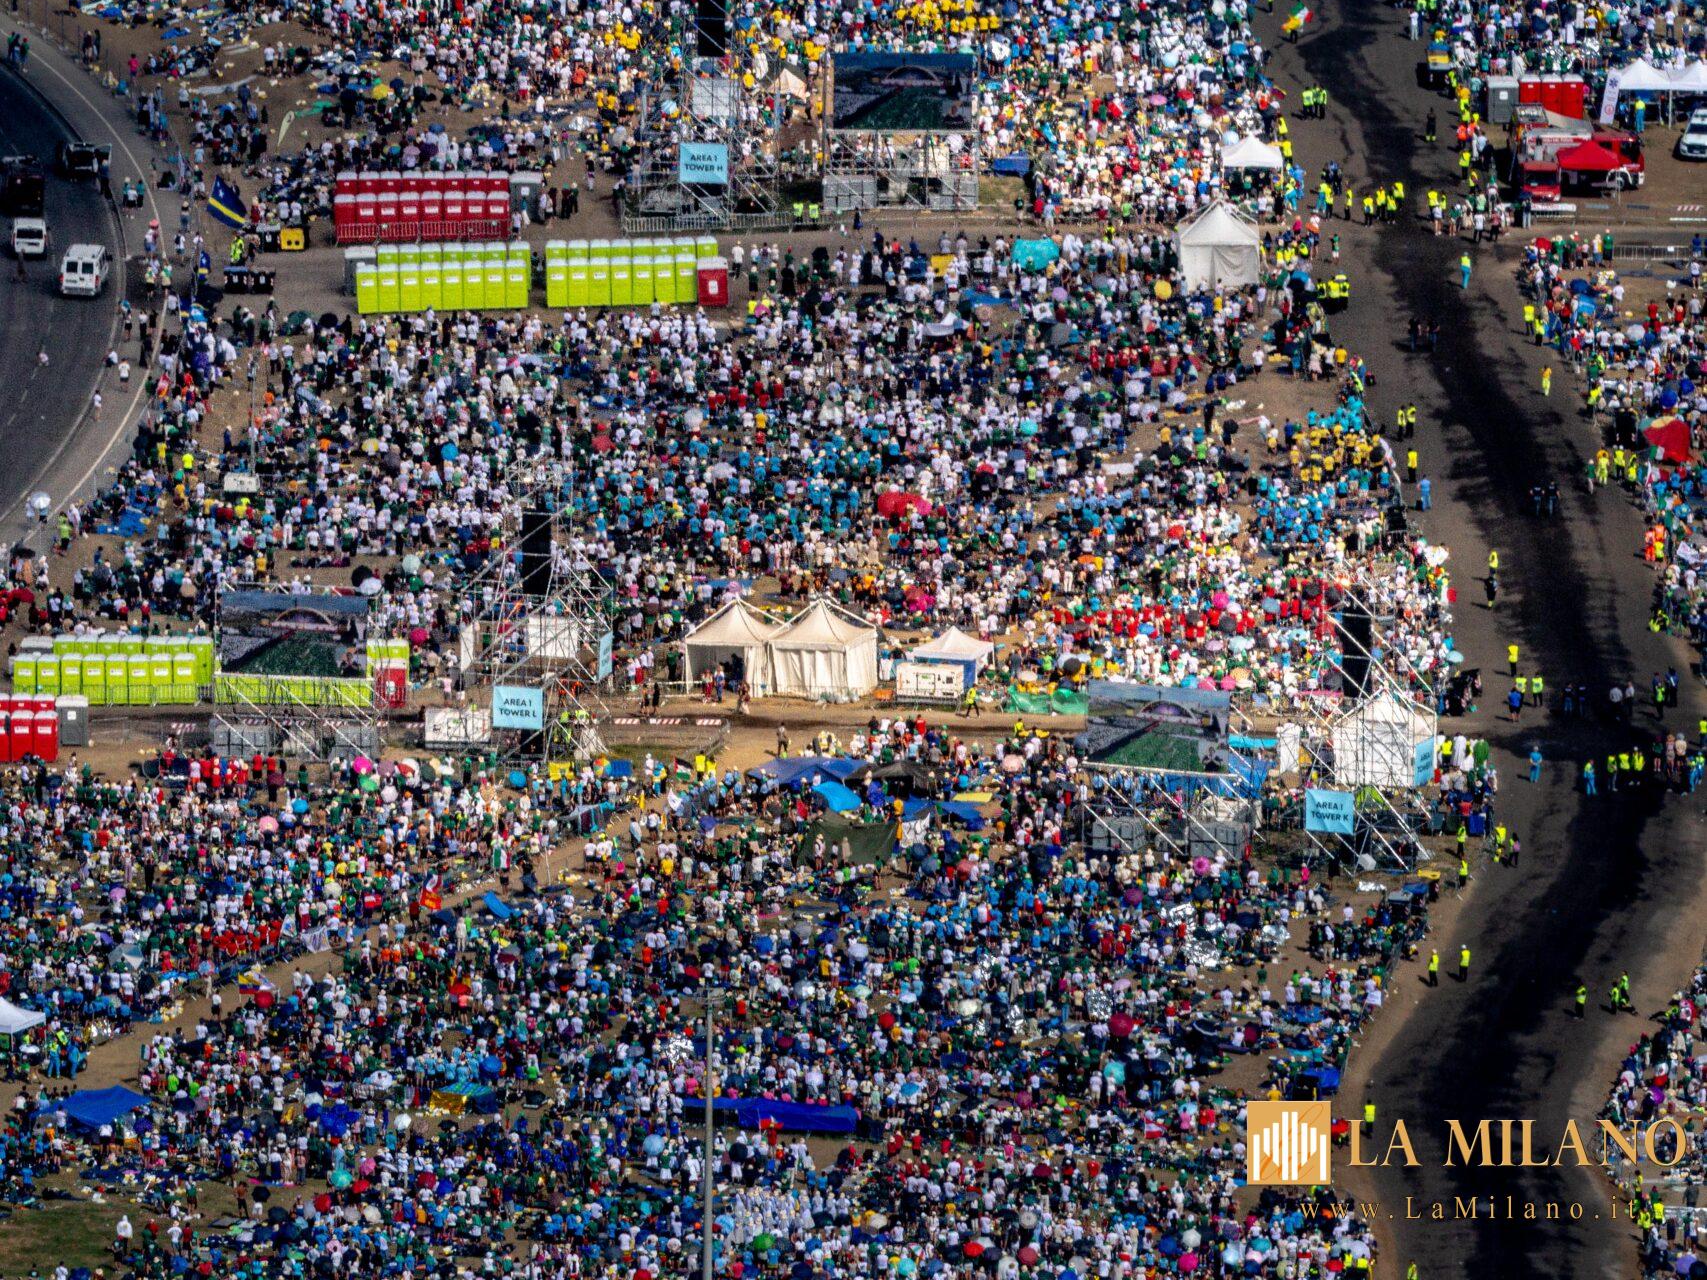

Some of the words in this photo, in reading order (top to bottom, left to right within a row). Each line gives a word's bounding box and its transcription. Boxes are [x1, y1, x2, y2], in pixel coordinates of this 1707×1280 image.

[690, 154, 712, 162] AREA
[684, 163, 715, 172] TOWER
[503, 698, 527, 707] AREA
[499, 707, 530, 717] TOWER
[1315, 801, 1339, 810] AREA
[1311, 810, 1341, 821] TOWER
